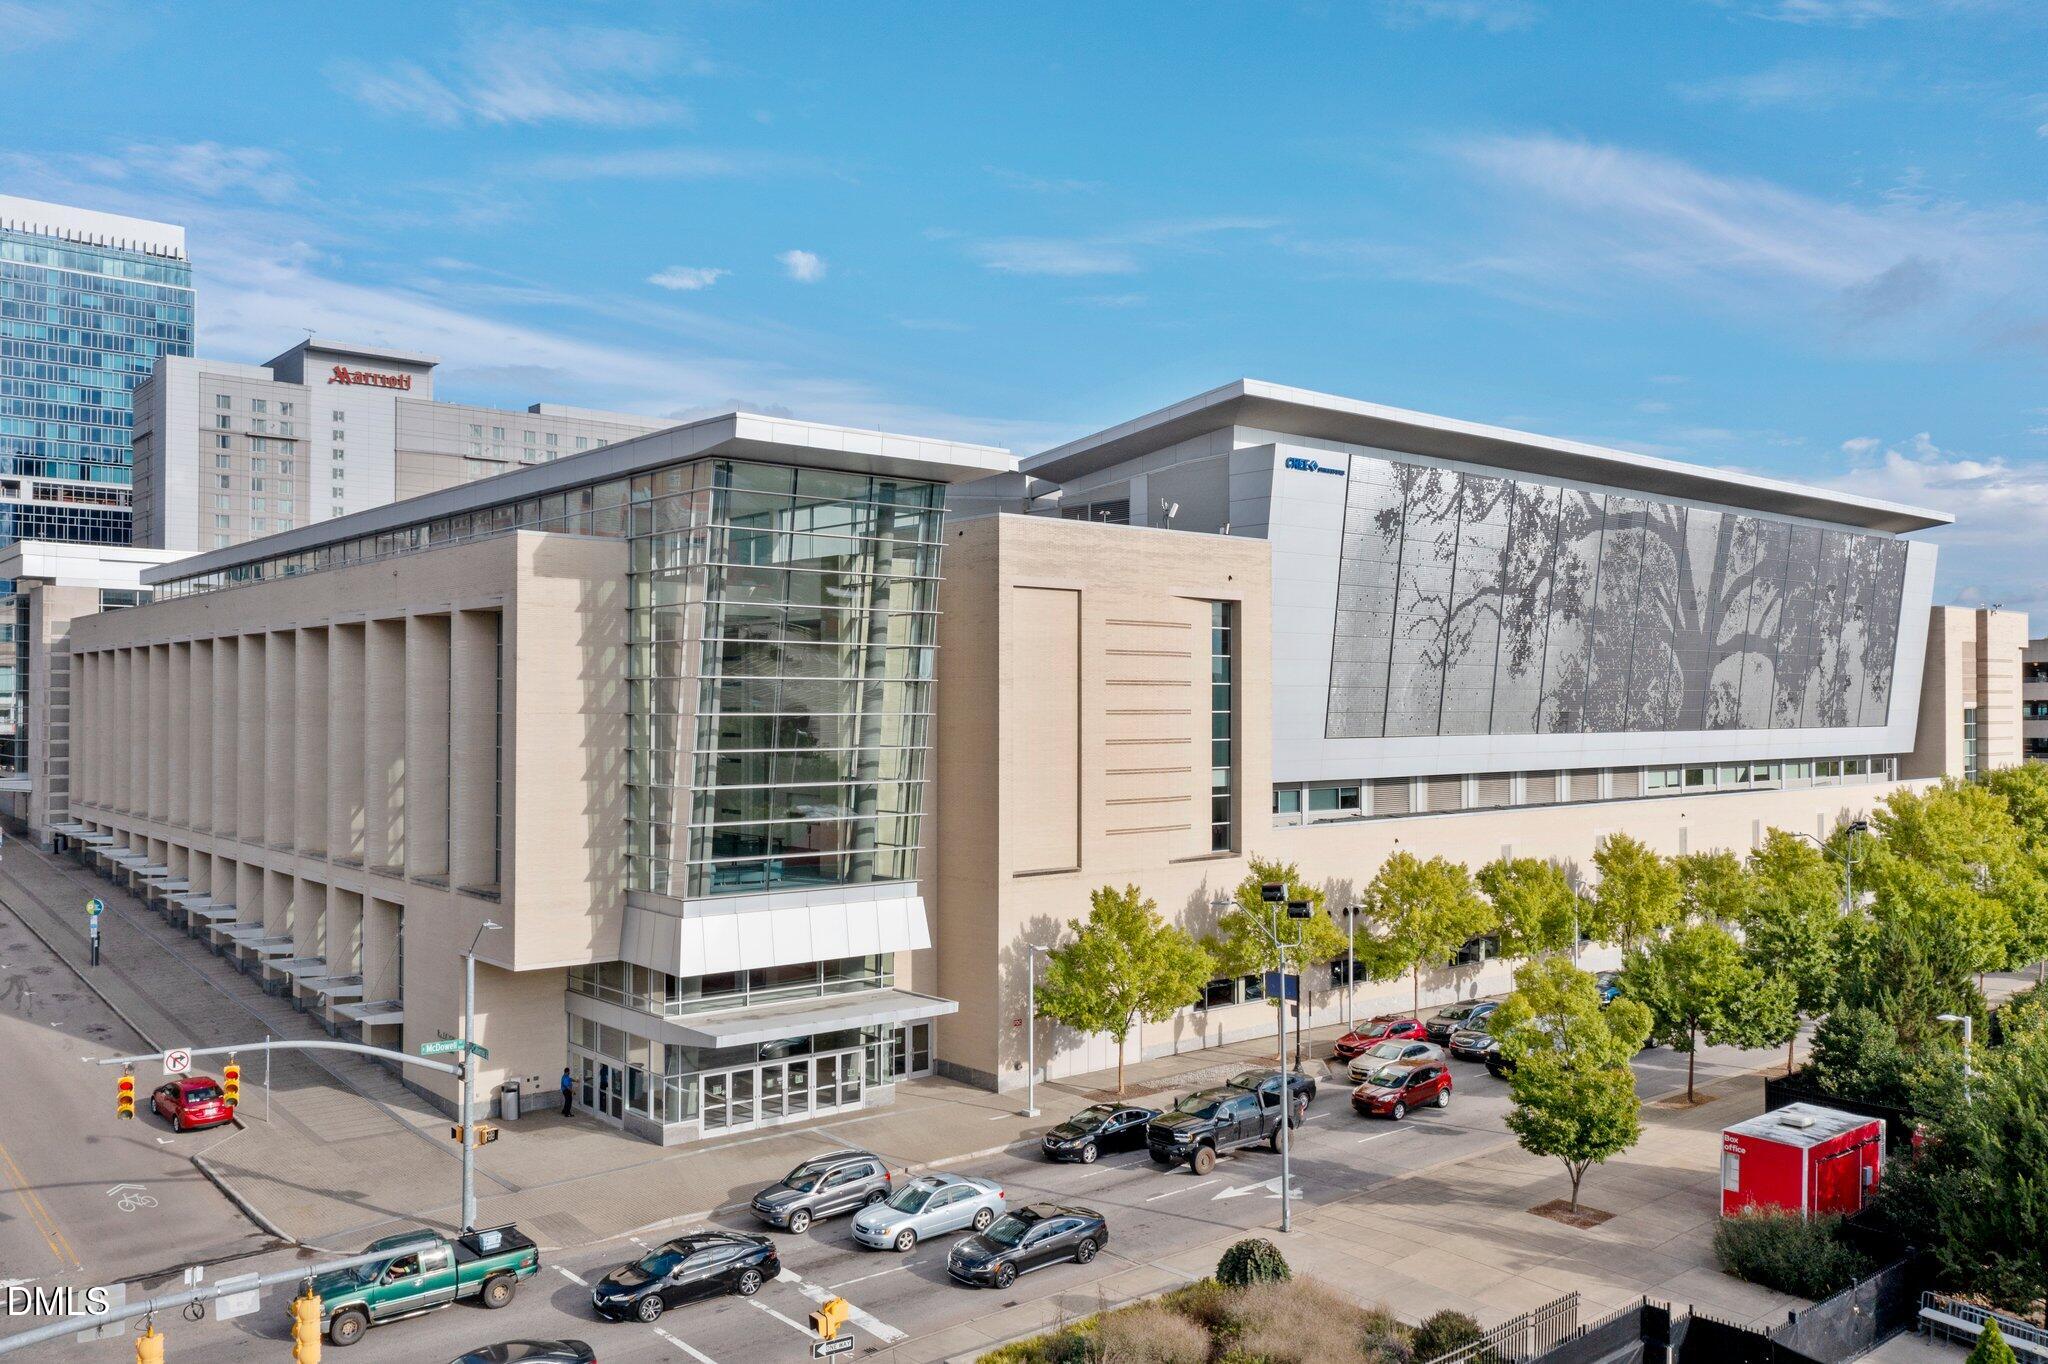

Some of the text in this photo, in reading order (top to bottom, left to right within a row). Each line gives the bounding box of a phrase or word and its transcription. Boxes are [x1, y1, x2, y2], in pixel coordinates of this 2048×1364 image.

[328, 366, 412, 390] Marriott
[426, 1042, 458, 1053] McDowell
[1724, 1135, 1739, 1144] Box
[1724, 1144, 1746, 1154] office
[838, 1340, 851, 1348] WAY
